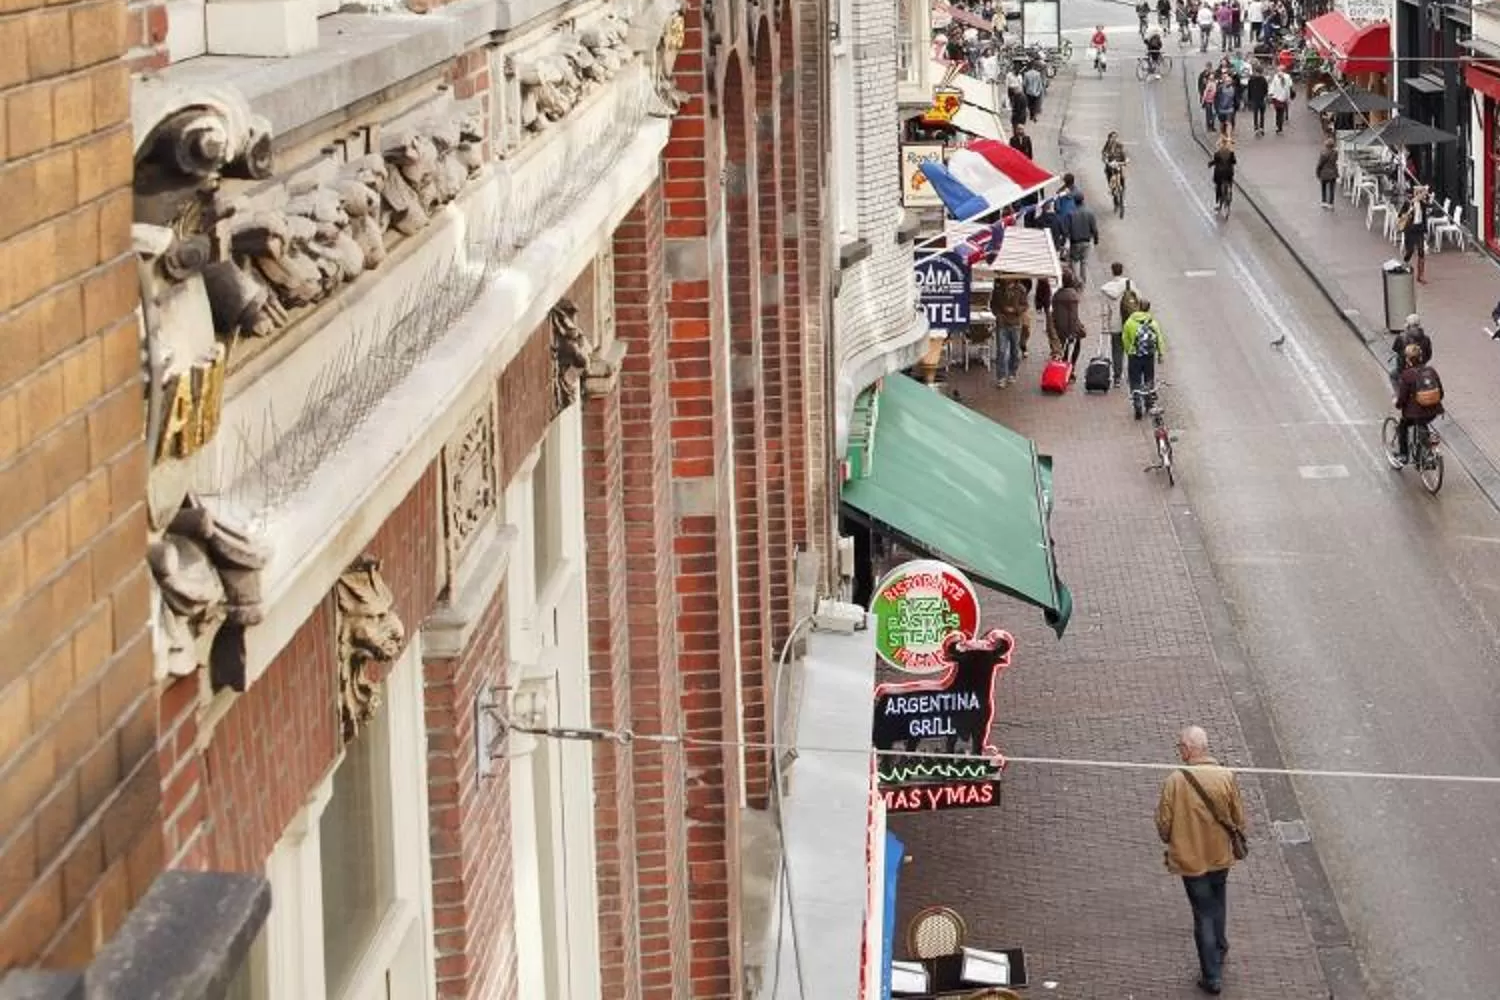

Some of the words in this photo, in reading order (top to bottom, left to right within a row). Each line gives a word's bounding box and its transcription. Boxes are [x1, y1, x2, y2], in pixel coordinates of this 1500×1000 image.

[884, 573, 966, 601] RISTORANTE
[898, 598, 951, 614] PIZZA
[885, 692, 980, 716] ARGENTINA
[909, 717, 957, 737] GRILL
[877, 789, 921, 810] MAS
[926, 788, 944, 811] Y
[945, 783, 993, 806] MAS
